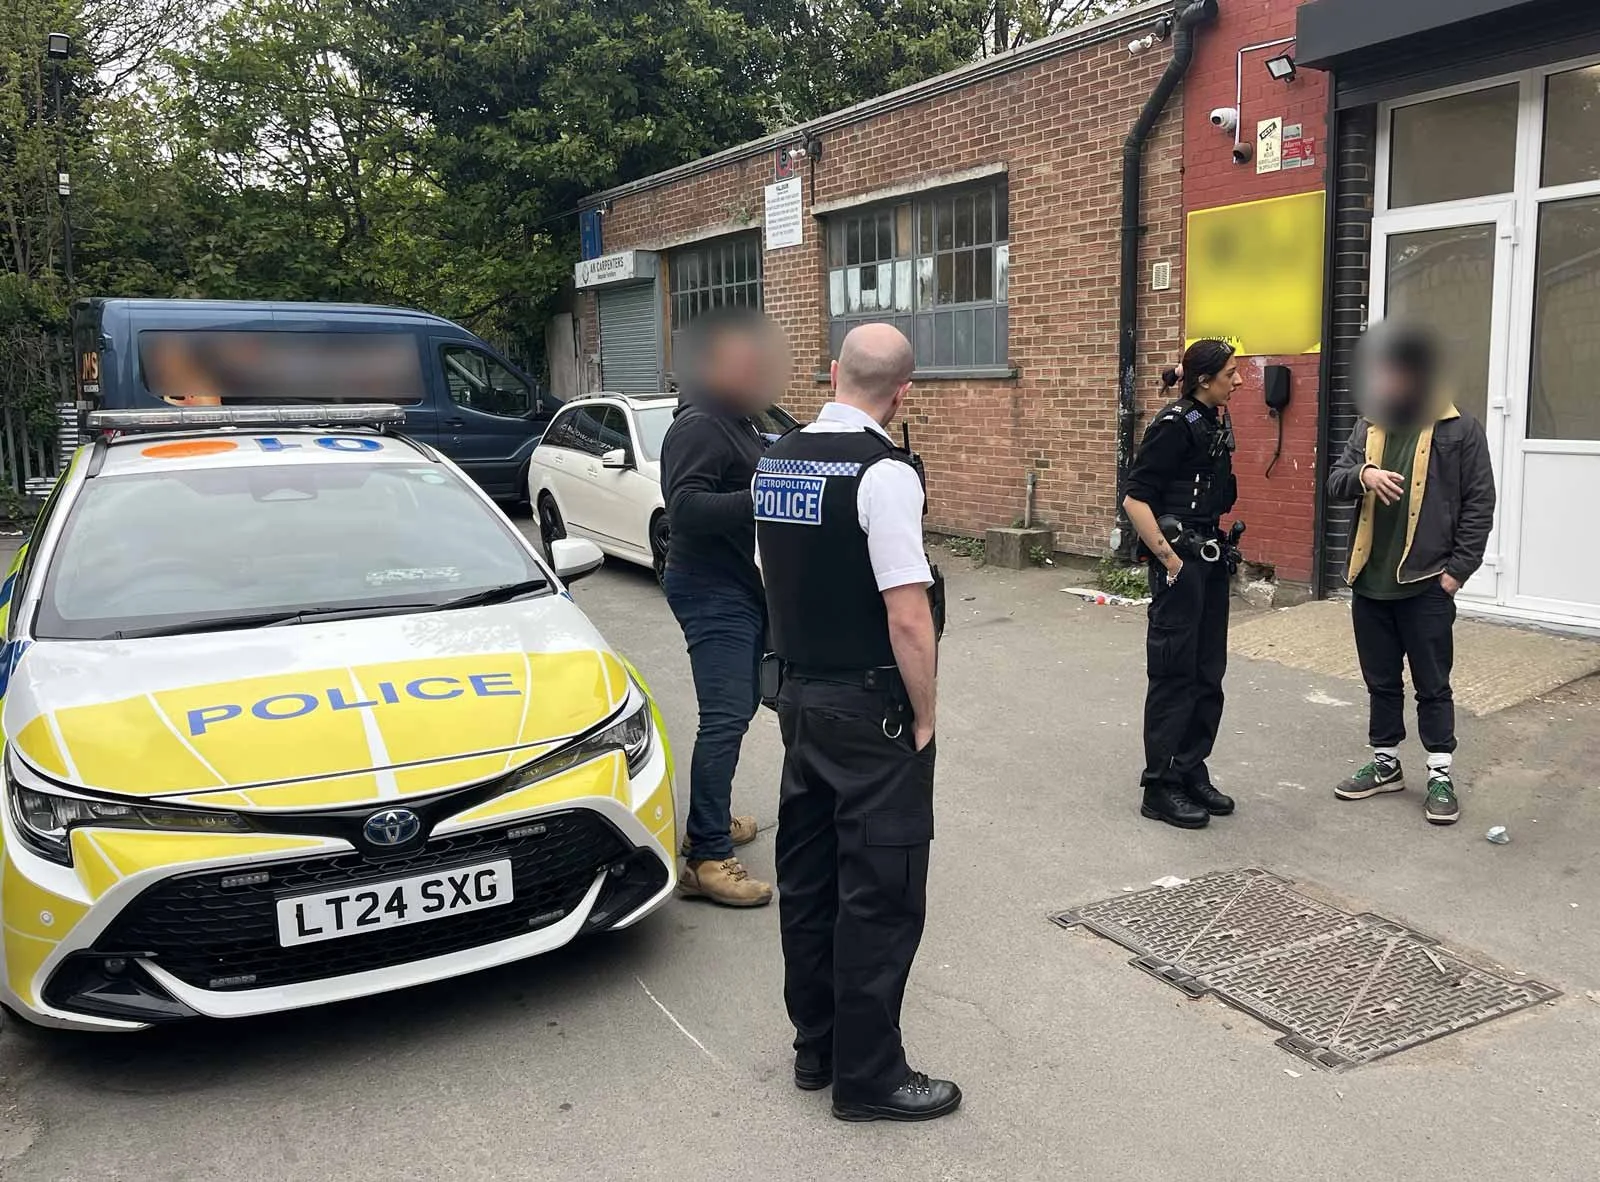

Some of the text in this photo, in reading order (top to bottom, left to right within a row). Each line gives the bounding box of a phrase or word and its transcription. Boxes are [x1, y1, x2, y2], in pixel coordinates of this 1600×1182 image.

[781, 146, 788, 162] 5
[1265, 141, 1273, 152] 24
[596, 256, 624, 272] CARPENTERS
[757, 478, 821, 491] METROPOLITAN
[755, 489, 818, 519] POLICE
[187, 673, 522, 737] POLICE
[294, 868, 498, 937] LT24 SXG
